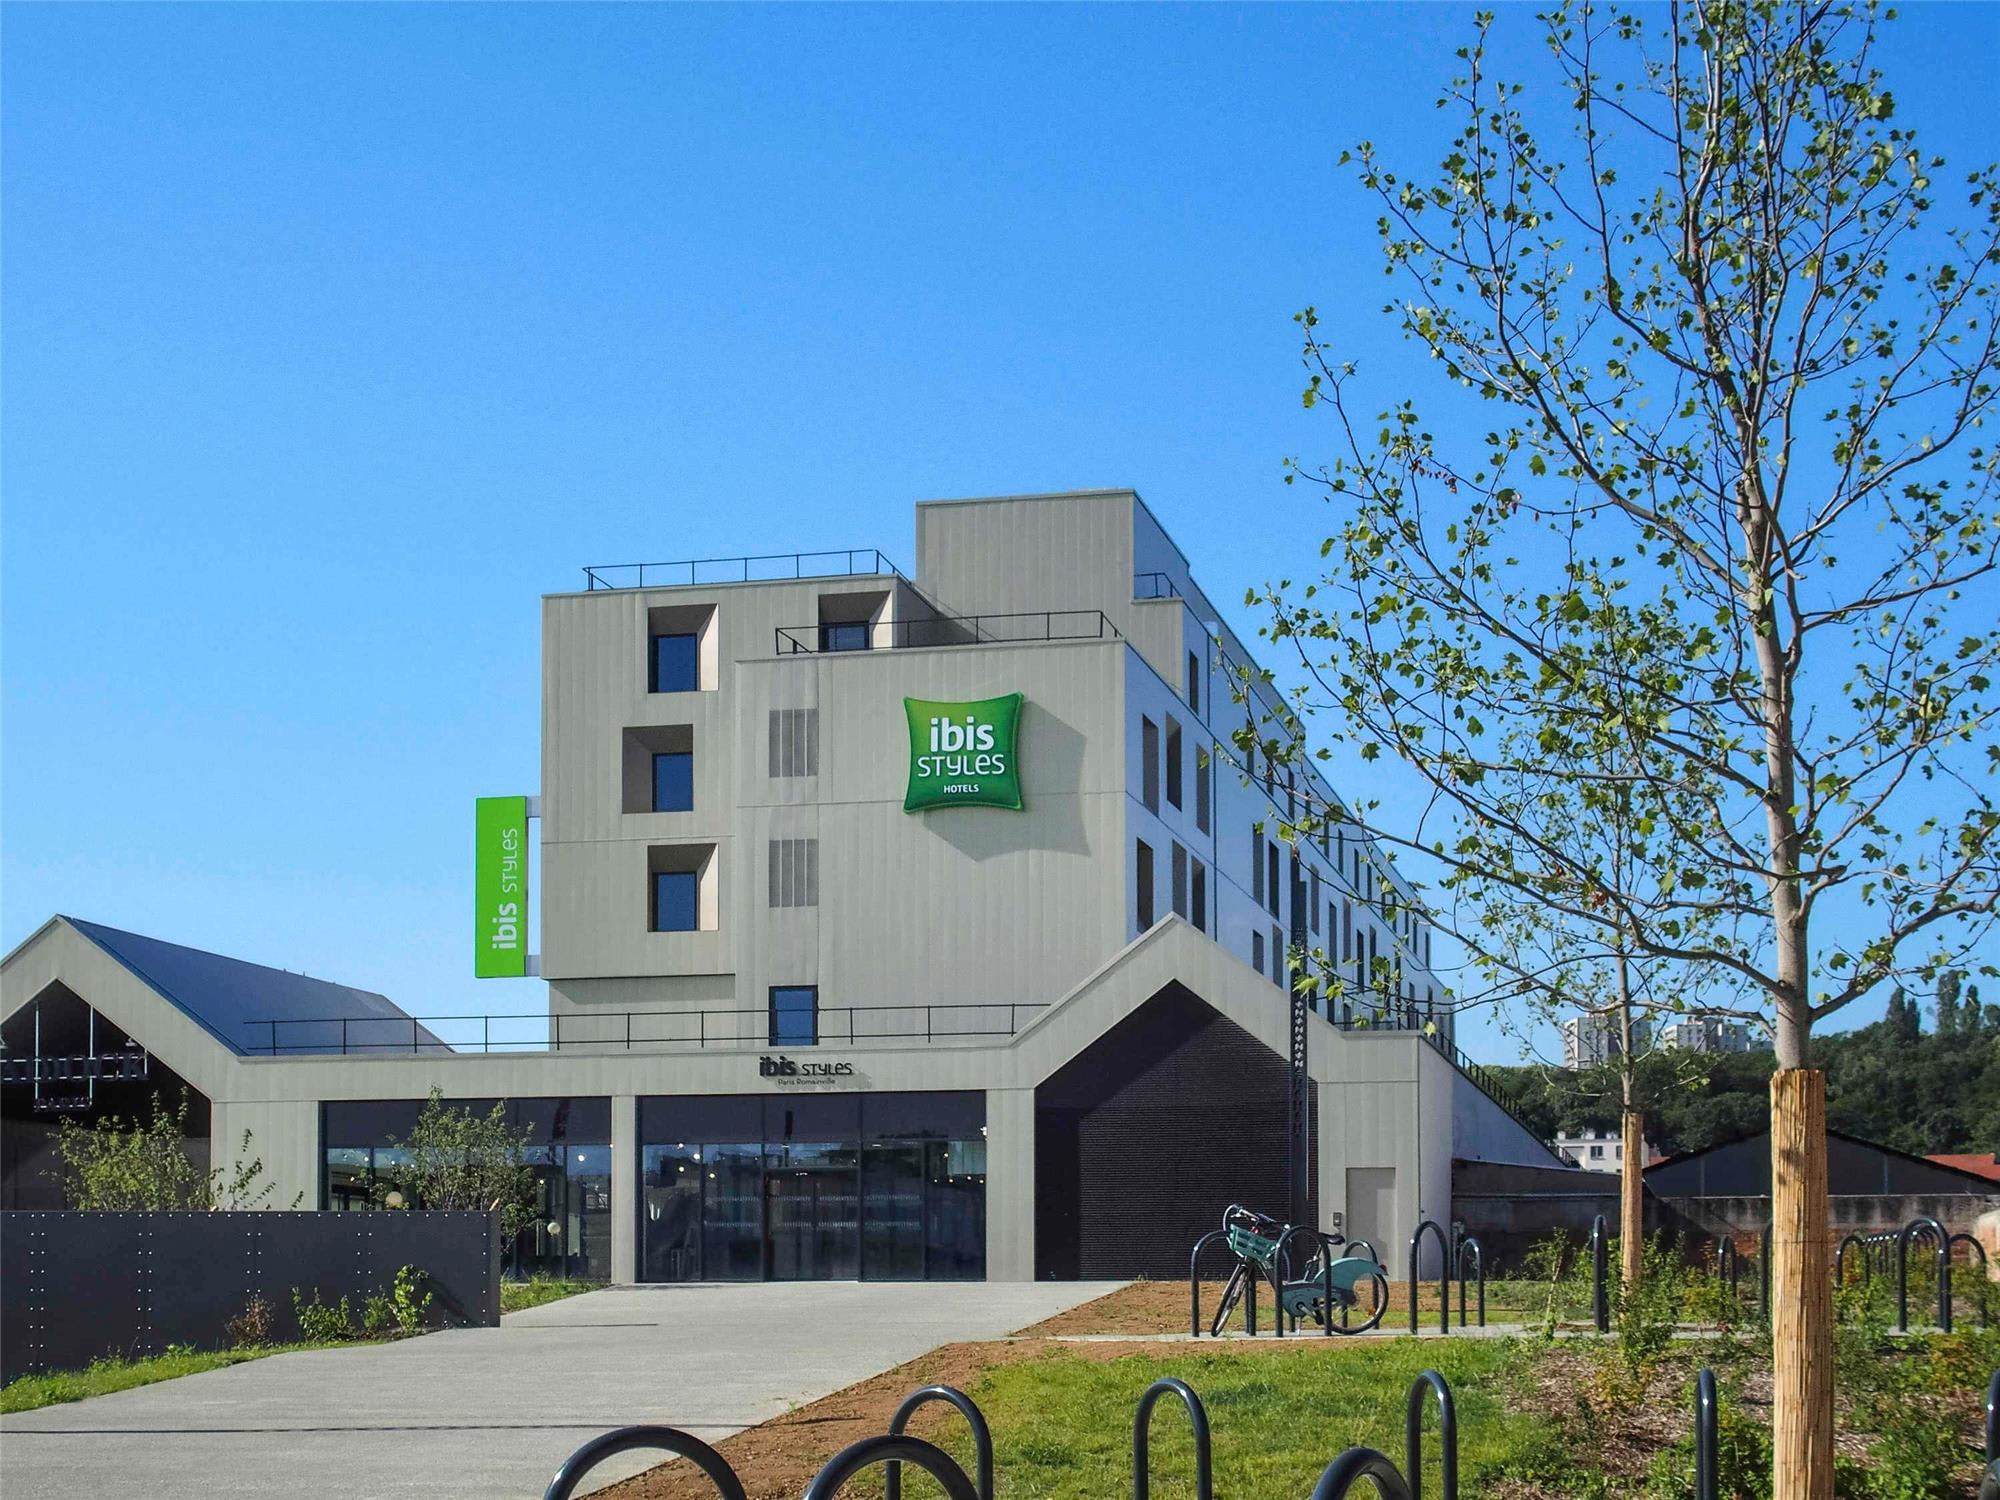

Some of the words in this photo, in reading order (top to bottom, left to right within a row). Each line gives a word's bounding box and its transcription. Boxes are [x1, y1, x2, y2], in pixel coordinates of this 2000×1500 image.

[930, 715, 995, 752] ibis
[943, 784, 980, 794] HOTELS
[492, 902, 518, 949] ibis
[759, 1055, 798, 1077] ibis
[777, 1078, 795, 1086] Paris
